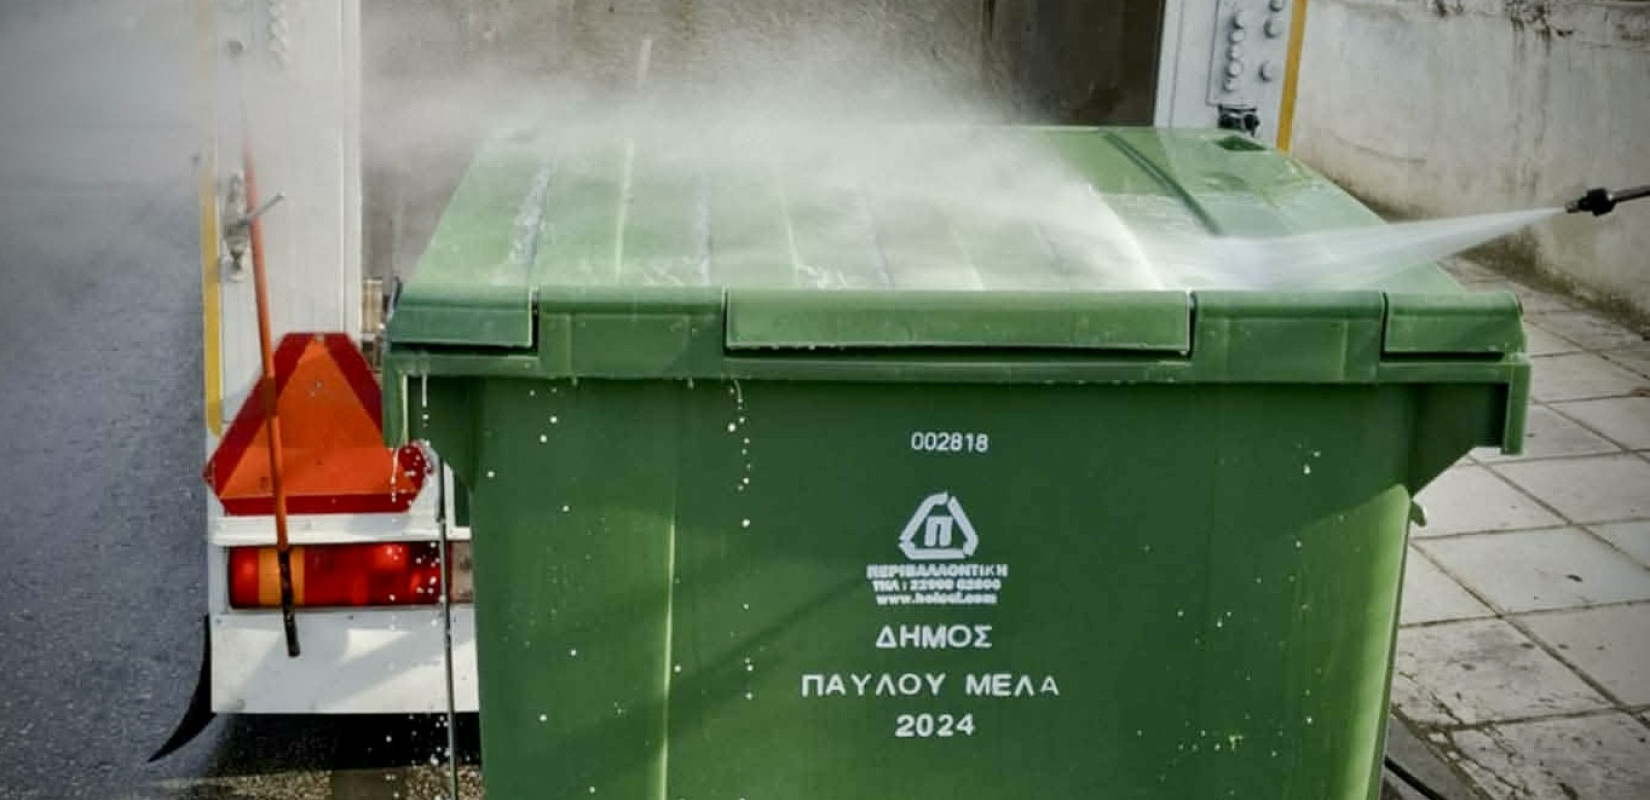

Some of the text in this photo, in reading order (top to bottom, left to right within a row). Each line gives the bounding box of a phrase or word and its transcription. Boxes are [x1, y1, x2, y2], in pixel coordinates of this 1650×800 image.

[911, 432, 988, 452] 002818
[876, 625, 992, 648] ΔΗΜΟΣ
[802, 674, 1059, 697] ΠΑΥΛΟΥ ΜΕΛΑ
[895, 714, 975, 737] 2024
